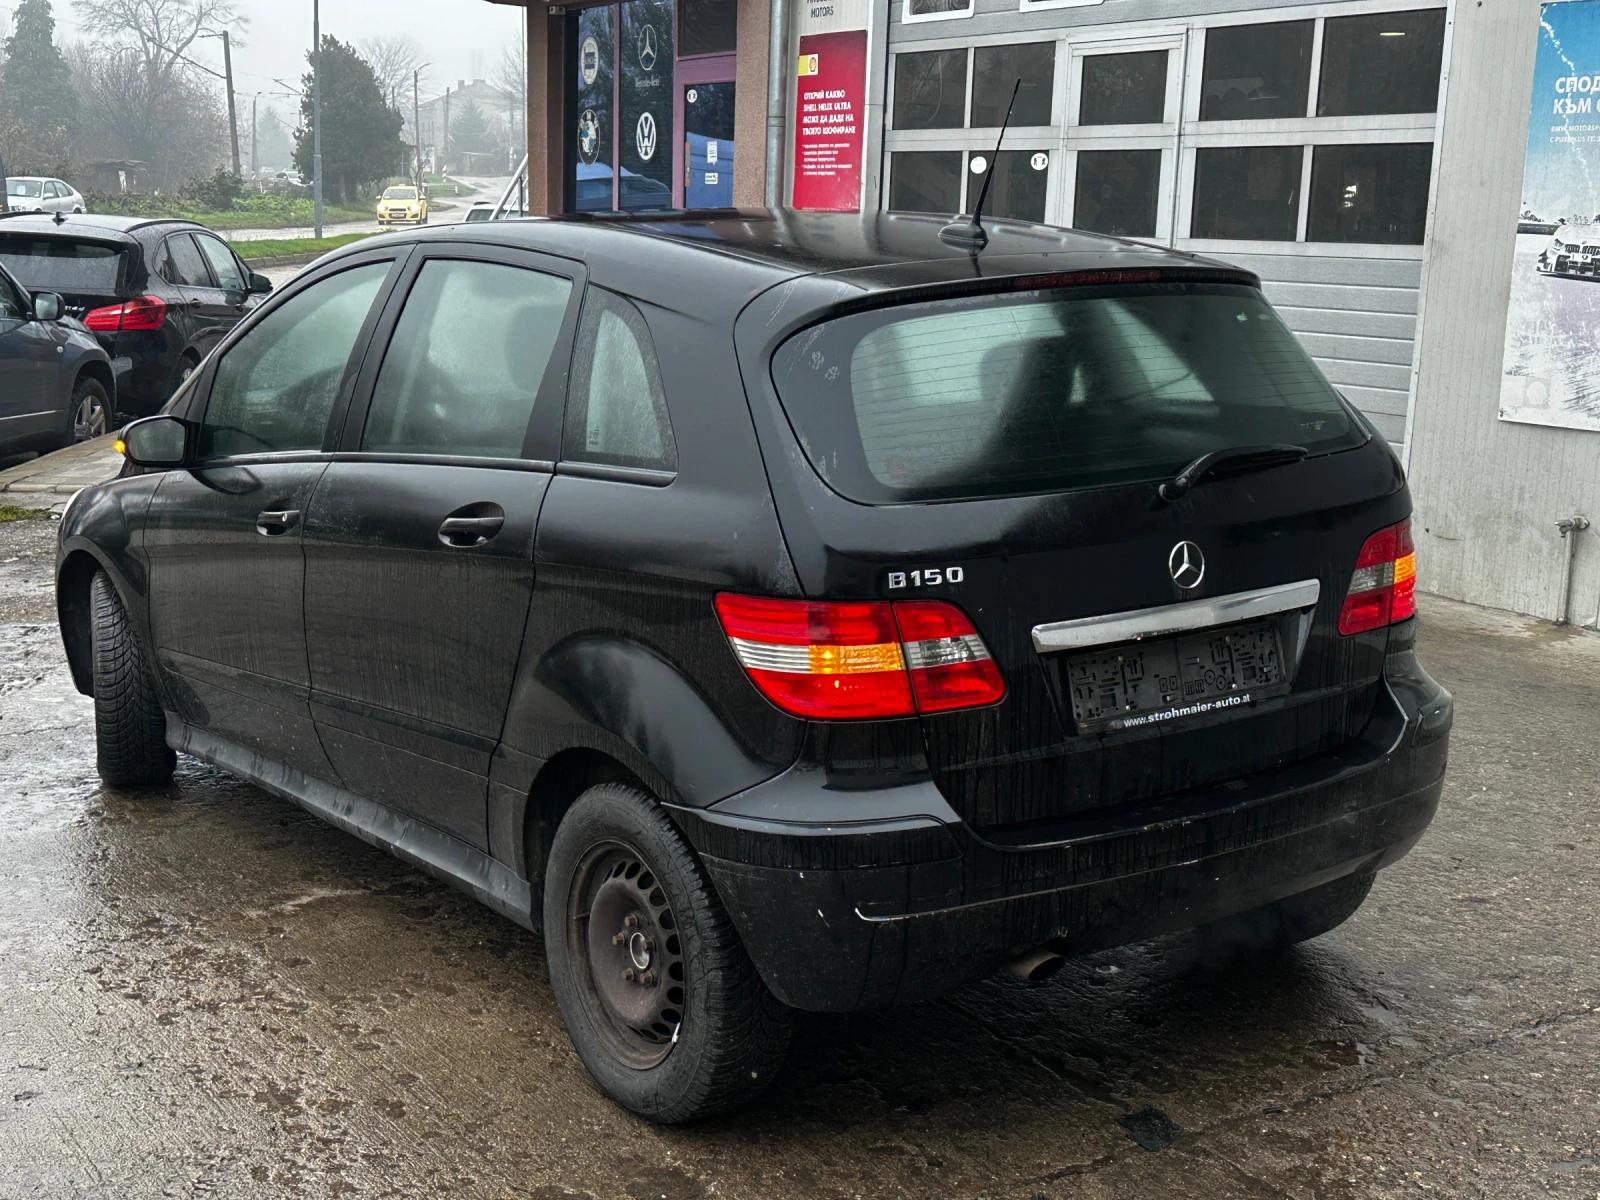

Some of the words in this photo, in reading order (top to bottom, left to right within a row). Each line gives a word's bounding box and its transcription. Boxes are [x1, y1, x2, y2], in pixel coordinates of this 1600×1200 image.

[811, 5, 834, 18] MOTORS
[1553, 98, 1592, 114] КЪМ
[888, 566, 964, 589] B150
[1123, 693, 1251, 727] www.strohmaier-auto.at
